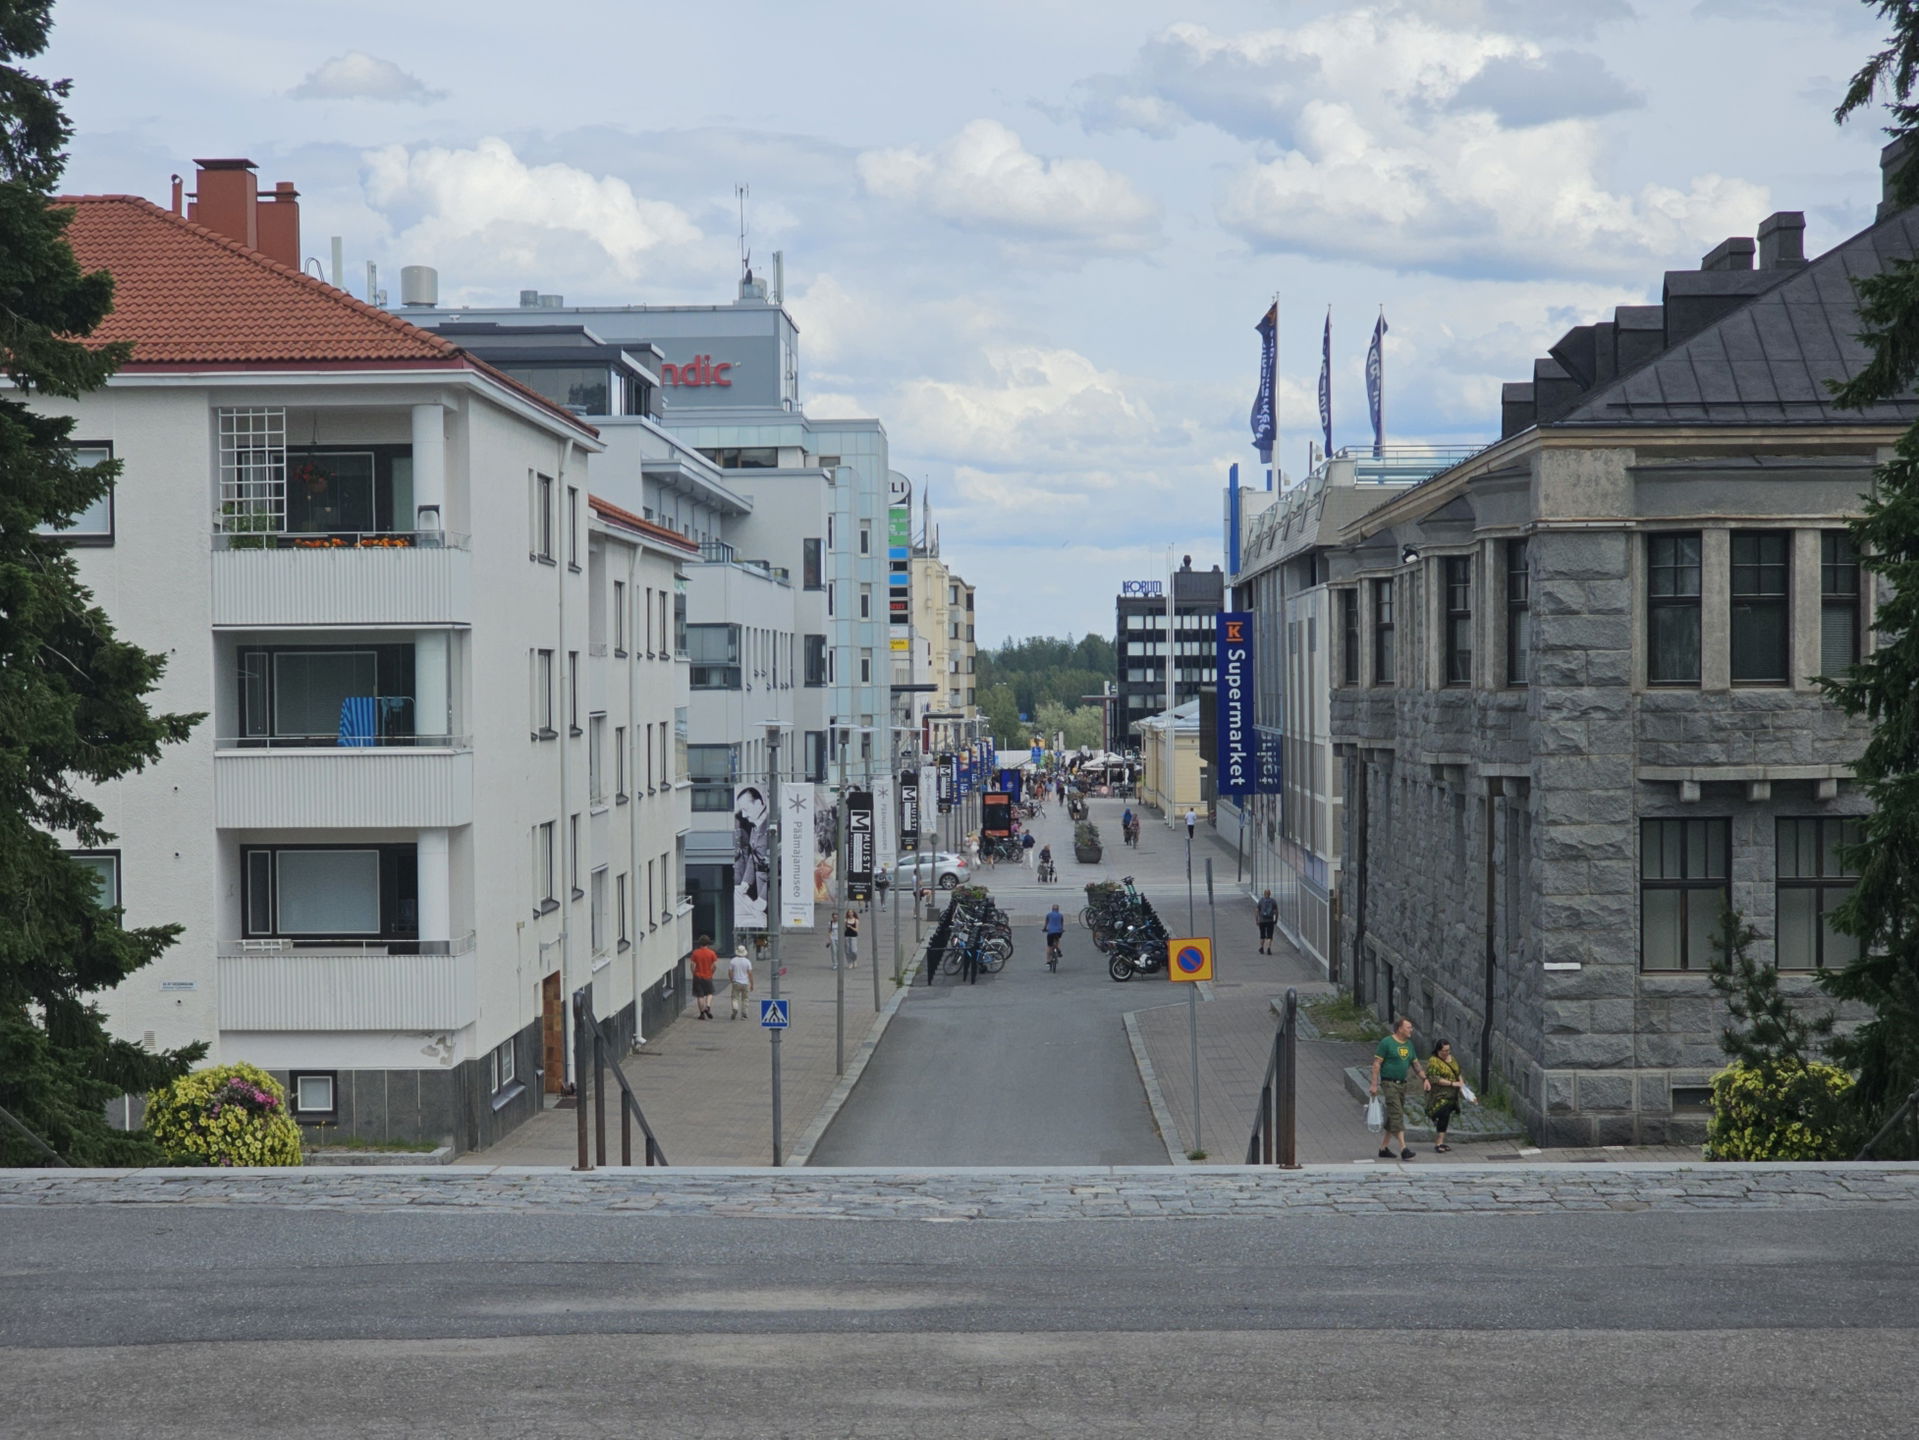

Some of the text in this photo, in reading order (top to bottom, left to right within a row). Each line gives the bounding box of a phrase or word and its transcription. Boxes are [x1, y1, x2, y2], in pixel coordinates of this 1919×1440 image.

[1228, 624, 1241, 639] K
[1225, 649, 1247, 785] Supermarket
[903, 786, 916, 801] M
[851, 811, 870, 832] M
[792, 821, 803, 898] Päämajamuseo
[863, 834, 871, 873] MUISTI
